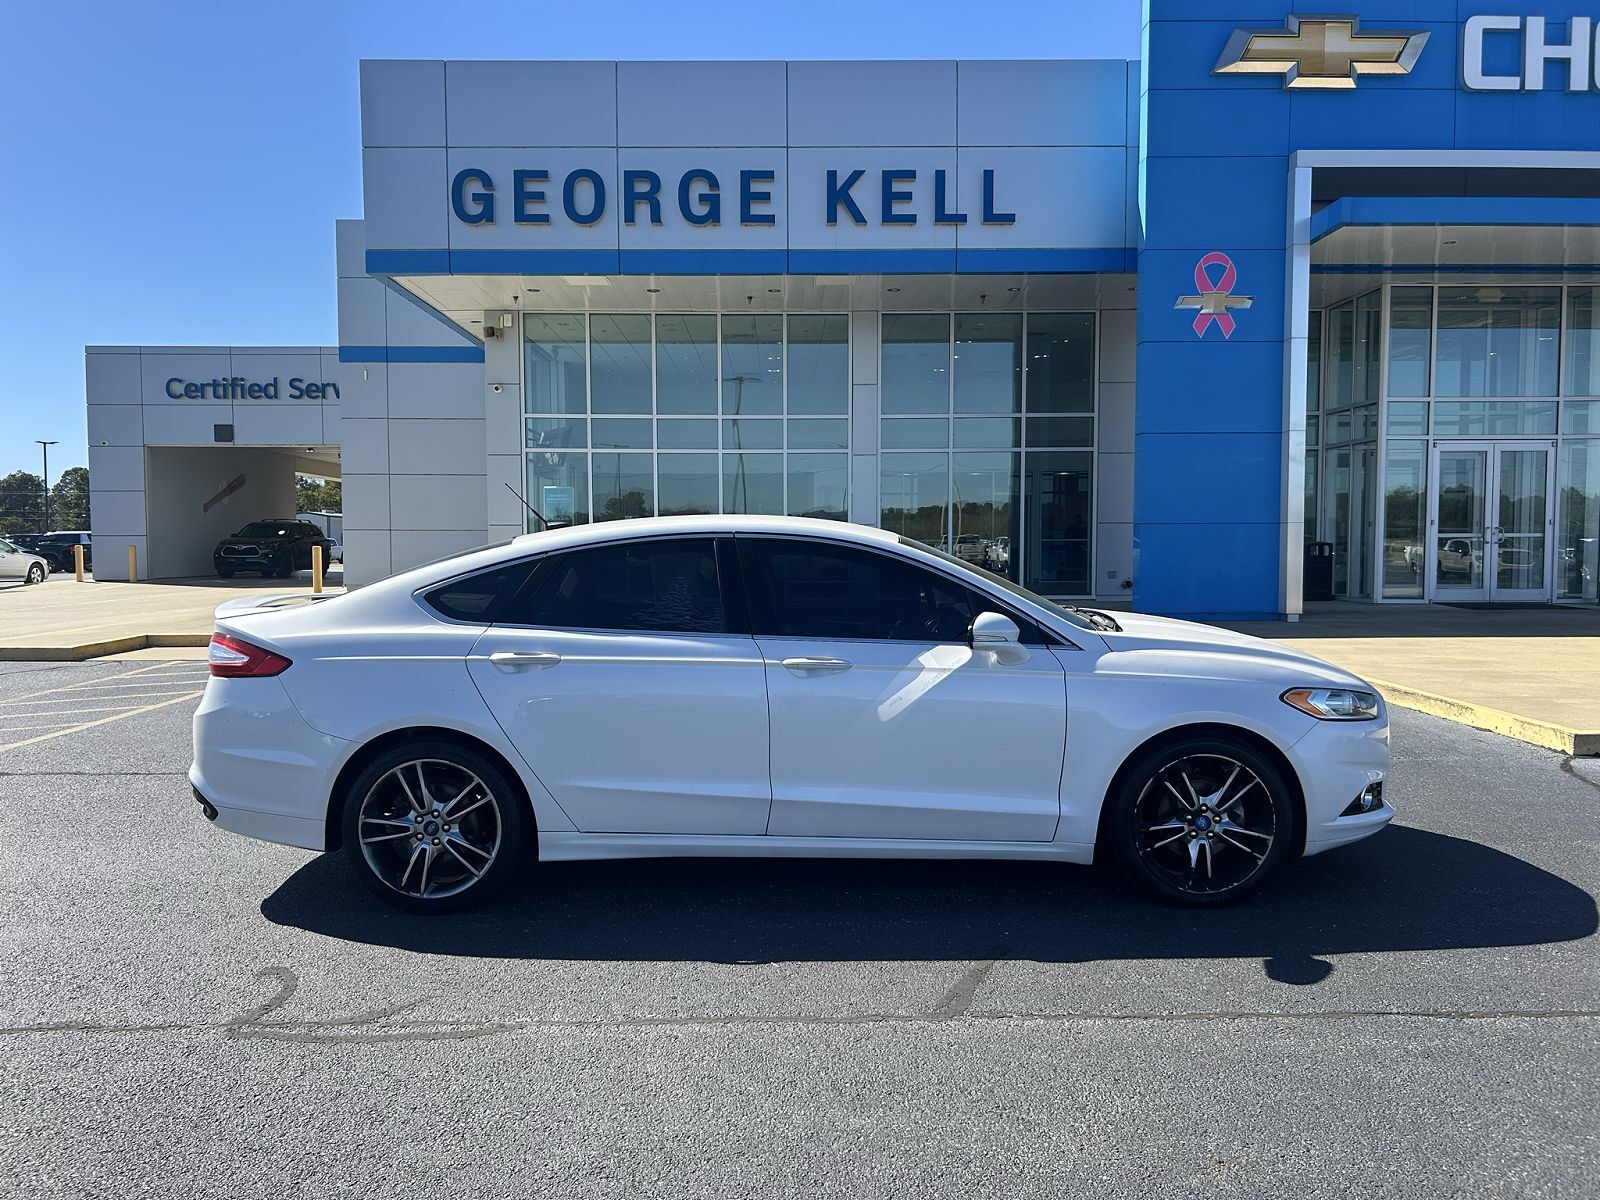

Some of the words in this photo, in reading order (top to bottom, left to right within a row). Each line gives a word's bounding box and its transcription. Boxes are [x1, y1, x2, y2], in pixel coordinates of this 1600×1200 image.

[1463, 15, 1600, 91] CH
[451, 168, 776, 227] GEORGE
[826, 169, 1016, 225] KELL
[165, 377, 279, 400] Certified
